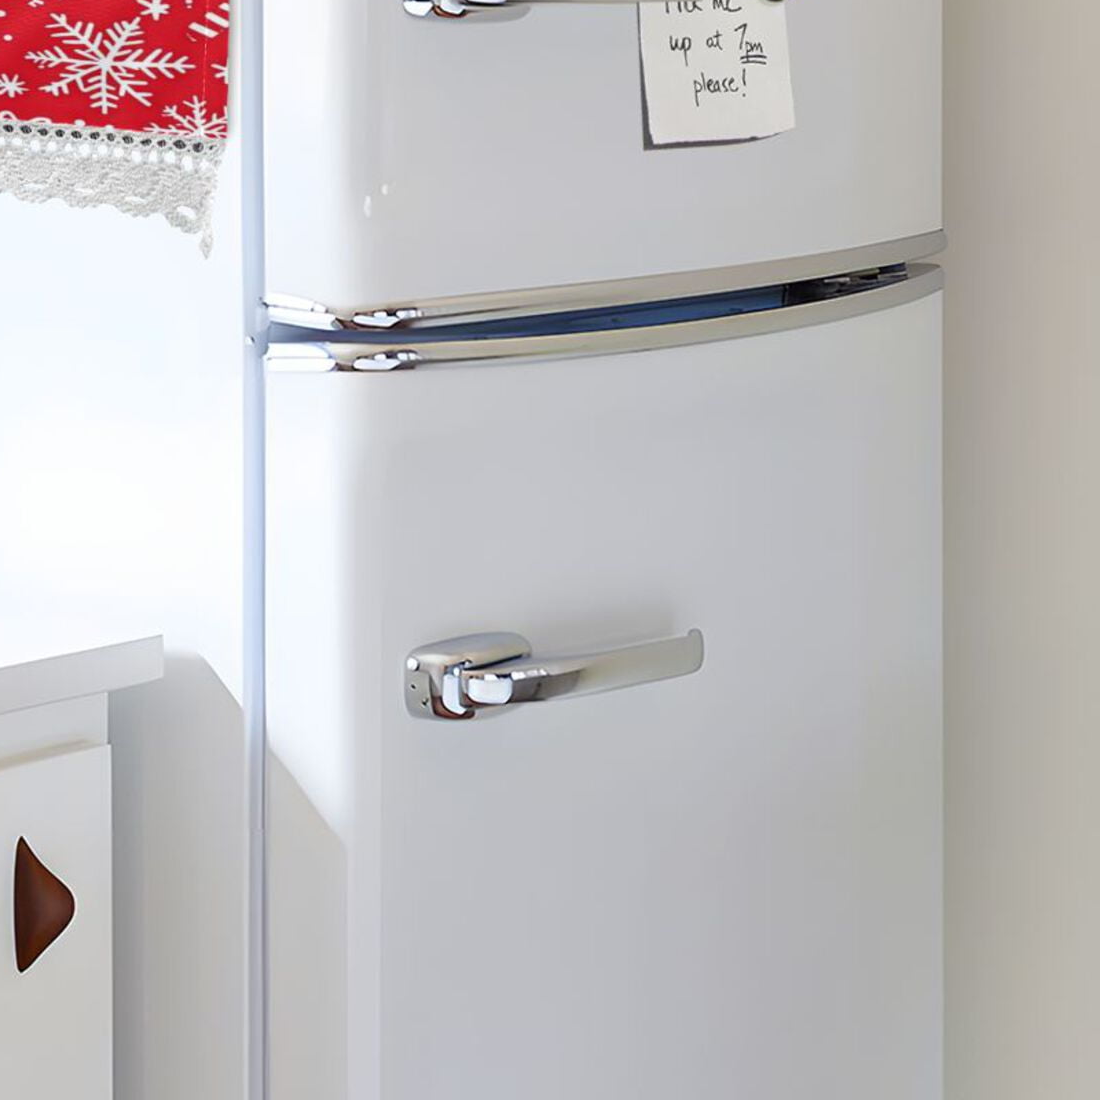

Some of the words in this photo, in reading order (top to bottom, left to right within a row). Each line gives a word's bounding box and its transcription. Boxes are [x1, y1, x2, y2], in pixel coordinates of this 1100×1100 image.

[669, 35, 692, 67] up
[706, 29, 723, 51] at
[693, 68, 747, 107] please!
